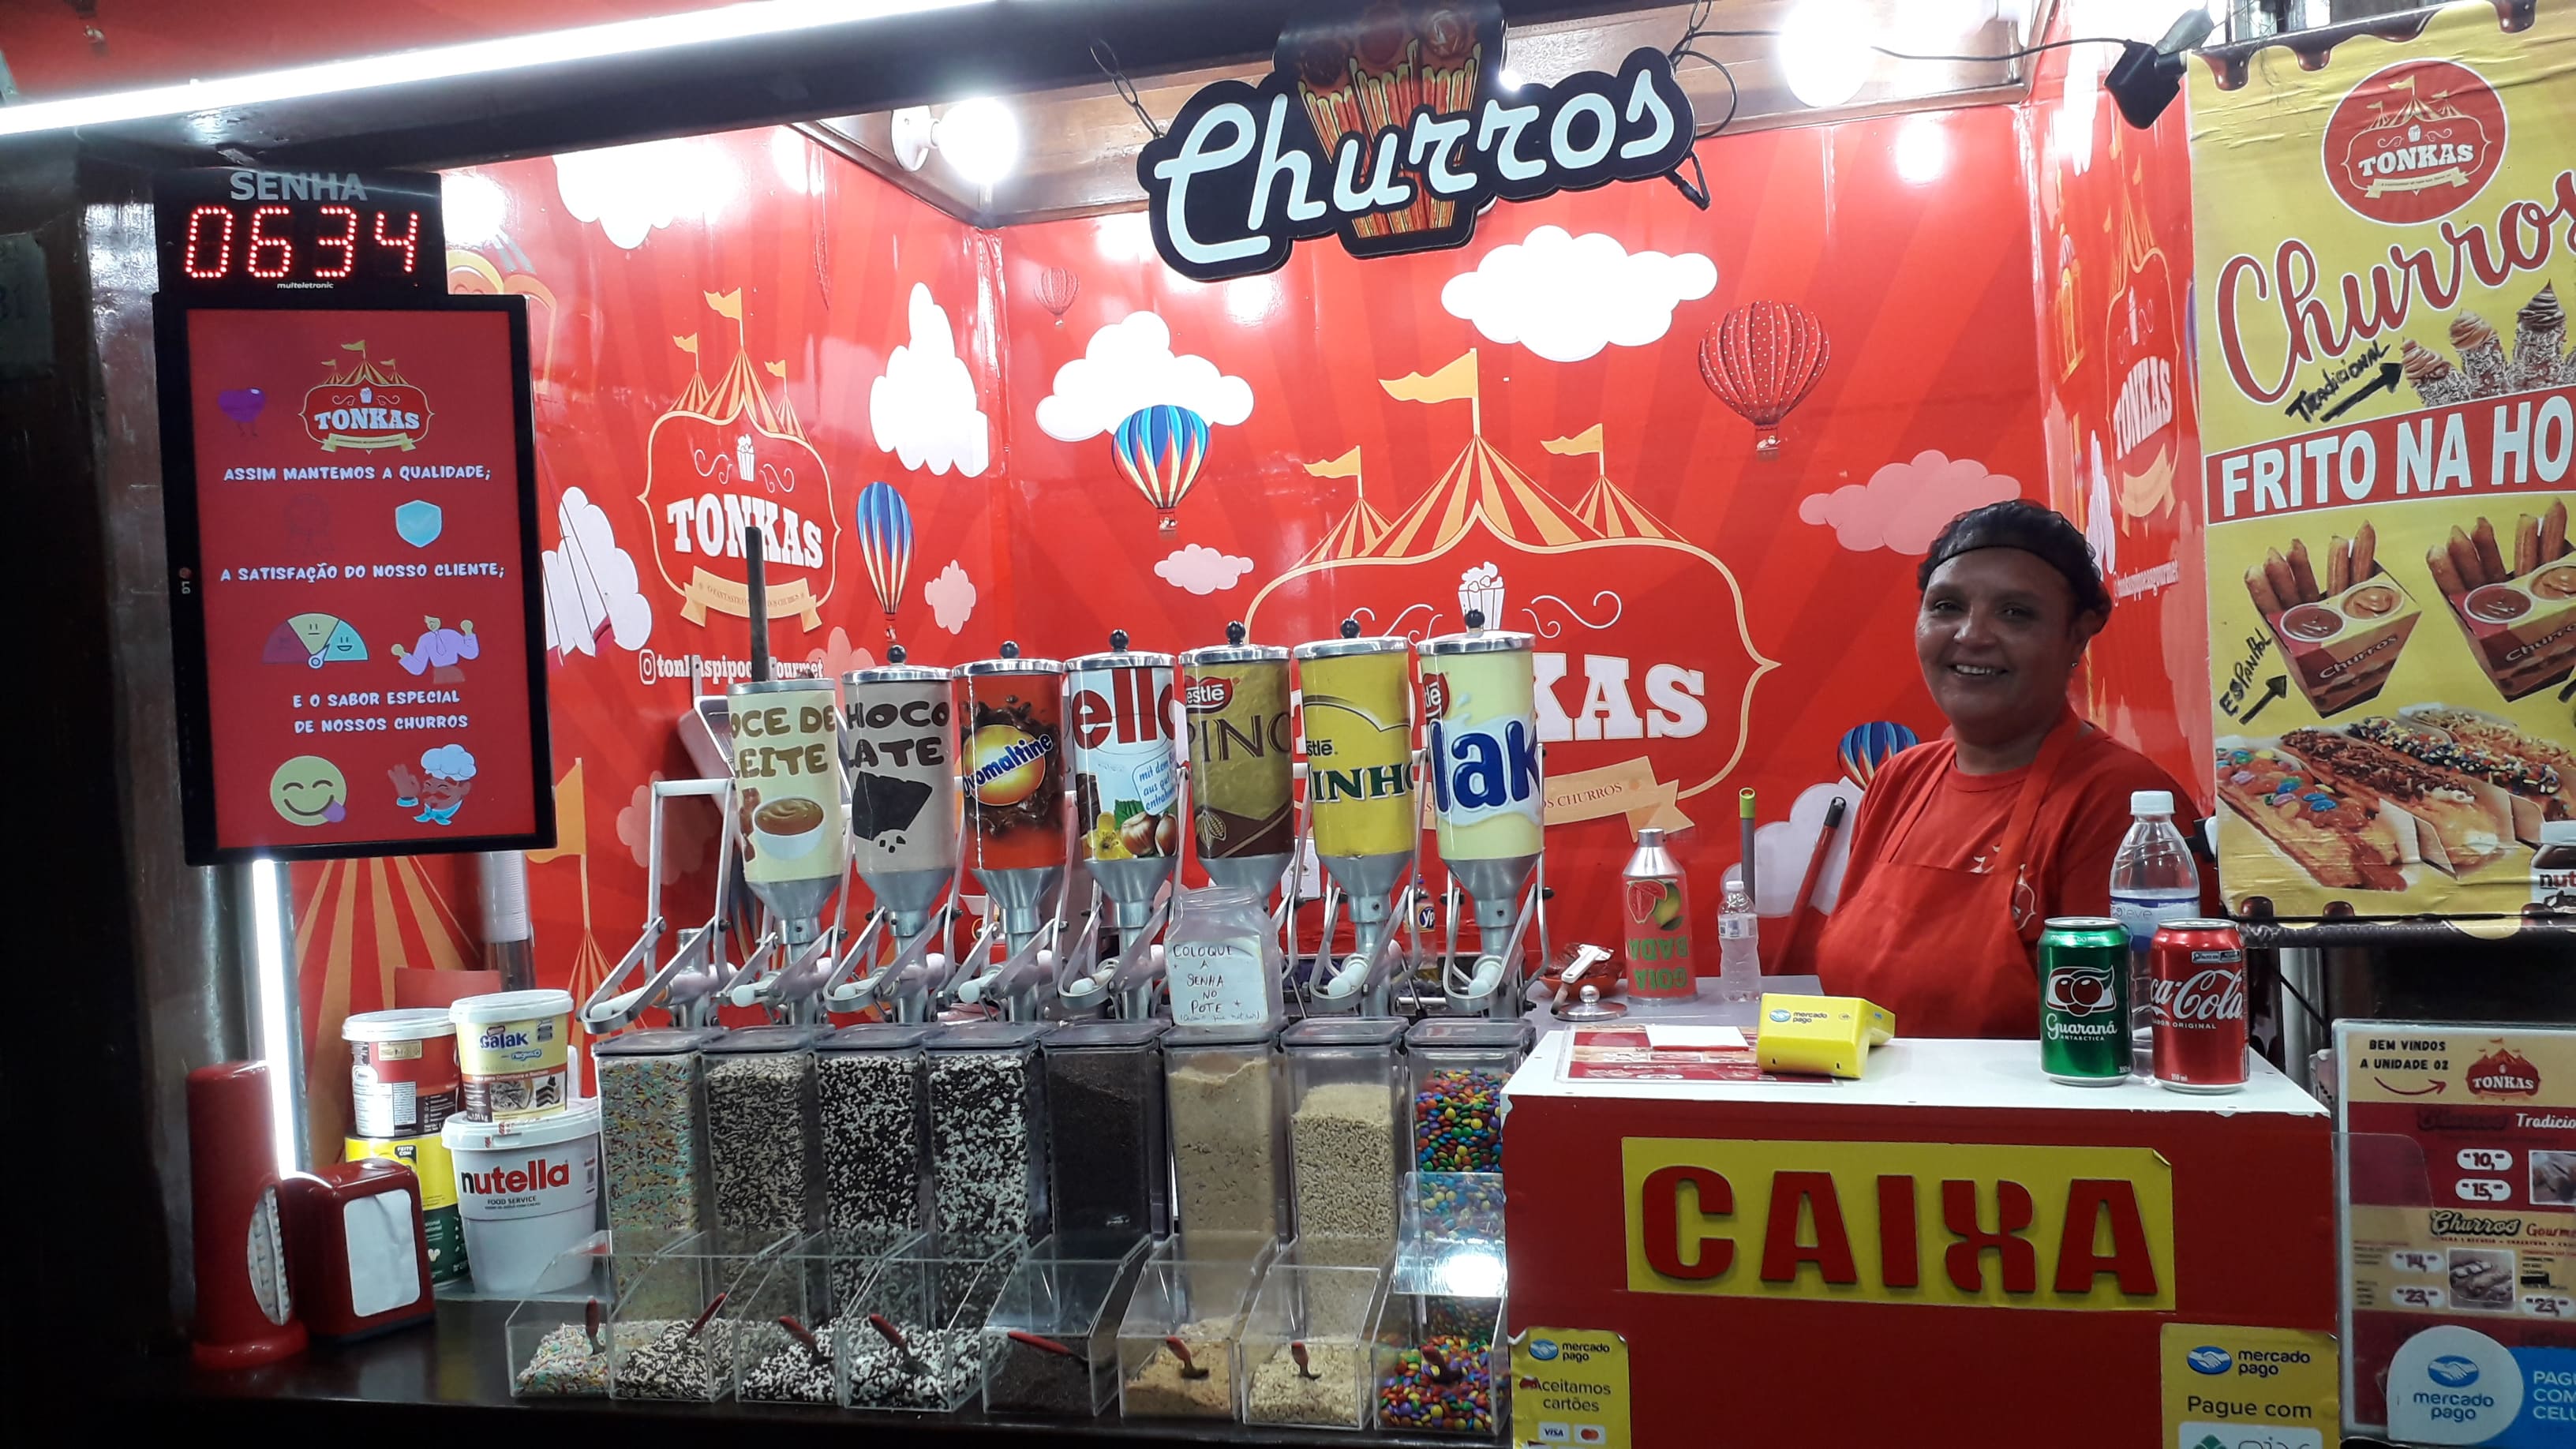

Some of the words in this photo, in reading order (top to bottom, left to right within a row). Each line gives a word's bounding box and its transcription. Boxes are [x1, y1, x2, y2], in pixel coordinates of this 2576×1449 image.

[1154, 69, 1674, 264] Churros
[2358, 144, 2474, 177] TONKAS
[230, 172, 368, 202] SENHA
[185, 206, 420, 278] 0634
[2113, 355, 2173, 461] TONKAS
[314, 407, 420, 431] TONKAS
[2222, 430, 2376, 518] FRITO
[2397, 414, 2472, 494] NA
[2491, 396, 2574, 486] HO
[224, 467, 276, 481] ASSIM
[283, 466, 375, 481] MANTEMOS
[383, 466, 392, 480] A
[399, 465, 491, 481] QUALIDADE;
[667, 493, 823, 569] TONKAS
[220, 569, 231, 581] A
[238, 563, 337, 584] SATISFAÇÃO
[345, 565, 365, 578] DO
[373, 564, 426, 578] NOSSO
[435, 562, 505, 578] CLIENTE;
[2320, 635, 2398, 679] Churros
[294, 695, 301, 708] E
[310, 694, 320, 706] O
[328, 692, 380, 706] SABOR
[388, 691, 460, 705] ESPECIAL
[1186, 683, 1225, 706] estlé
[294, 721, 314, 734] DE
[322, 717, 387, 732] NOSSOS
[394, 715, 468, 730] CHURROS
[963, 732, 1054, 799] Ovomaltine
[1556, 782, 1623, 809] CHURROS
[1200, 959, 1209, 970] A
[1186, 973, 1224, 987] SENHA
[1203, 990, 1218, 999] NO
[1191, 999, 1222, 1014] POTE
[2046, 1013, 2118, 1040] Guaraná
[480, 1032, 529, 1050] Galak
[2369, 1039, 2396, 1050] BEM
[2401, 1040, 2446, 1051] VINDOS
[2360, 1058, 2368, 1069] A
[2374, 1059, 2428, 1070] UNIDADE
[2472, 1076, 2534, 1090] TONKAS
[461, 1159, 570, 1195] nutella
[507, 1196, 537, 1204] SERVICE
[1642, 1165, 2159, 1295] CAIXA
[2431, 1210, 2521, 1237] Churros
[1562, 1342, 1610, 1353] mercado
[1563, 1353, 1589, 1363] pago
[2238, 1350, 2311, 1364] mercado
[2238, 1363, 2279, 1377] pago
[1543, 1397, 1600, 1412] cartões
[2188, 1395, 2257, 1418] Pague
[2265, 1403, 2312, 1418] com
[2413, 1391, 2495, 1407] mercado
[2431, 1407, 2476, 1422] pago
[1544, 1428, 1563, 1437] VISA
